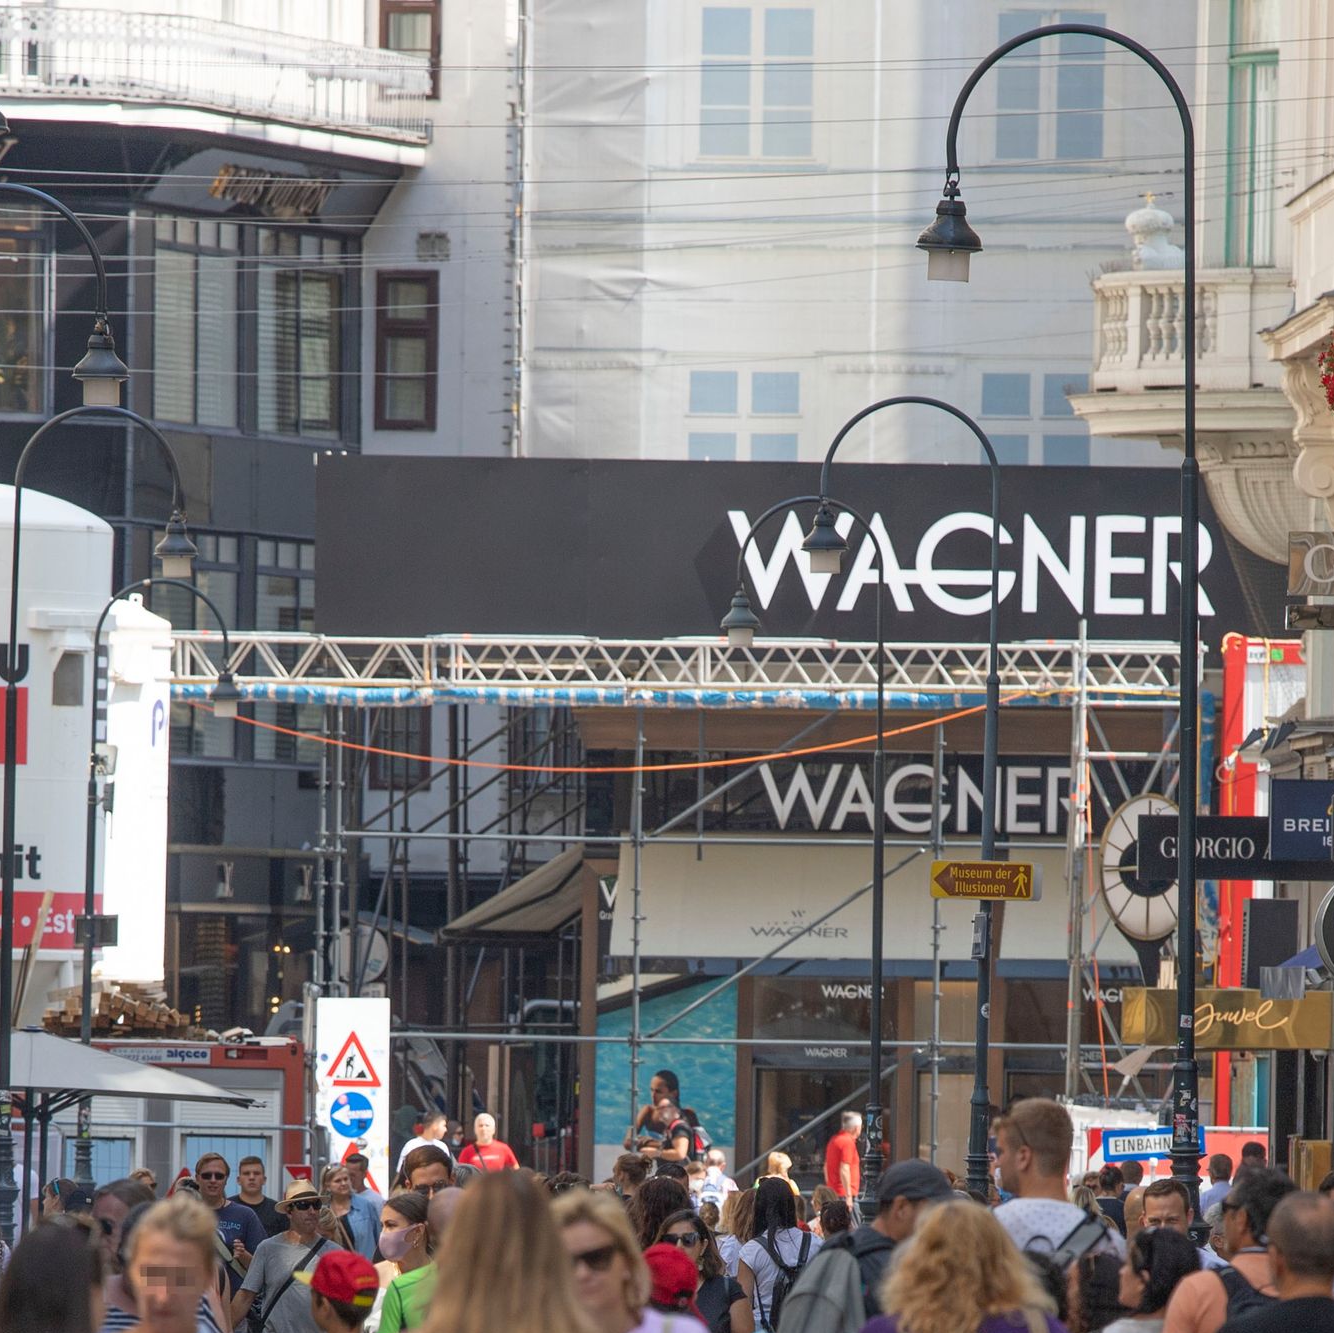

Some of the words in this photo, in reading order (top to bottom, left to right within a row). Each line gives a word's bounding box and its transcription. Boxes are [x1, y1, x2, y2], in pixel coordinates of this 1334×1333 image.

[727, 510, 1216, 616] WAGNER
[759, 762, 1092, 834] WAGNER
[950, 866, 992, 879] Museum
[995, 868, 1012, 880] der
[955, 881, 1006, 894] Illusionen
[804, 1047, 847, 1058] WAGNER
[1114, 1137, 1173, 1153] EINBAHN
